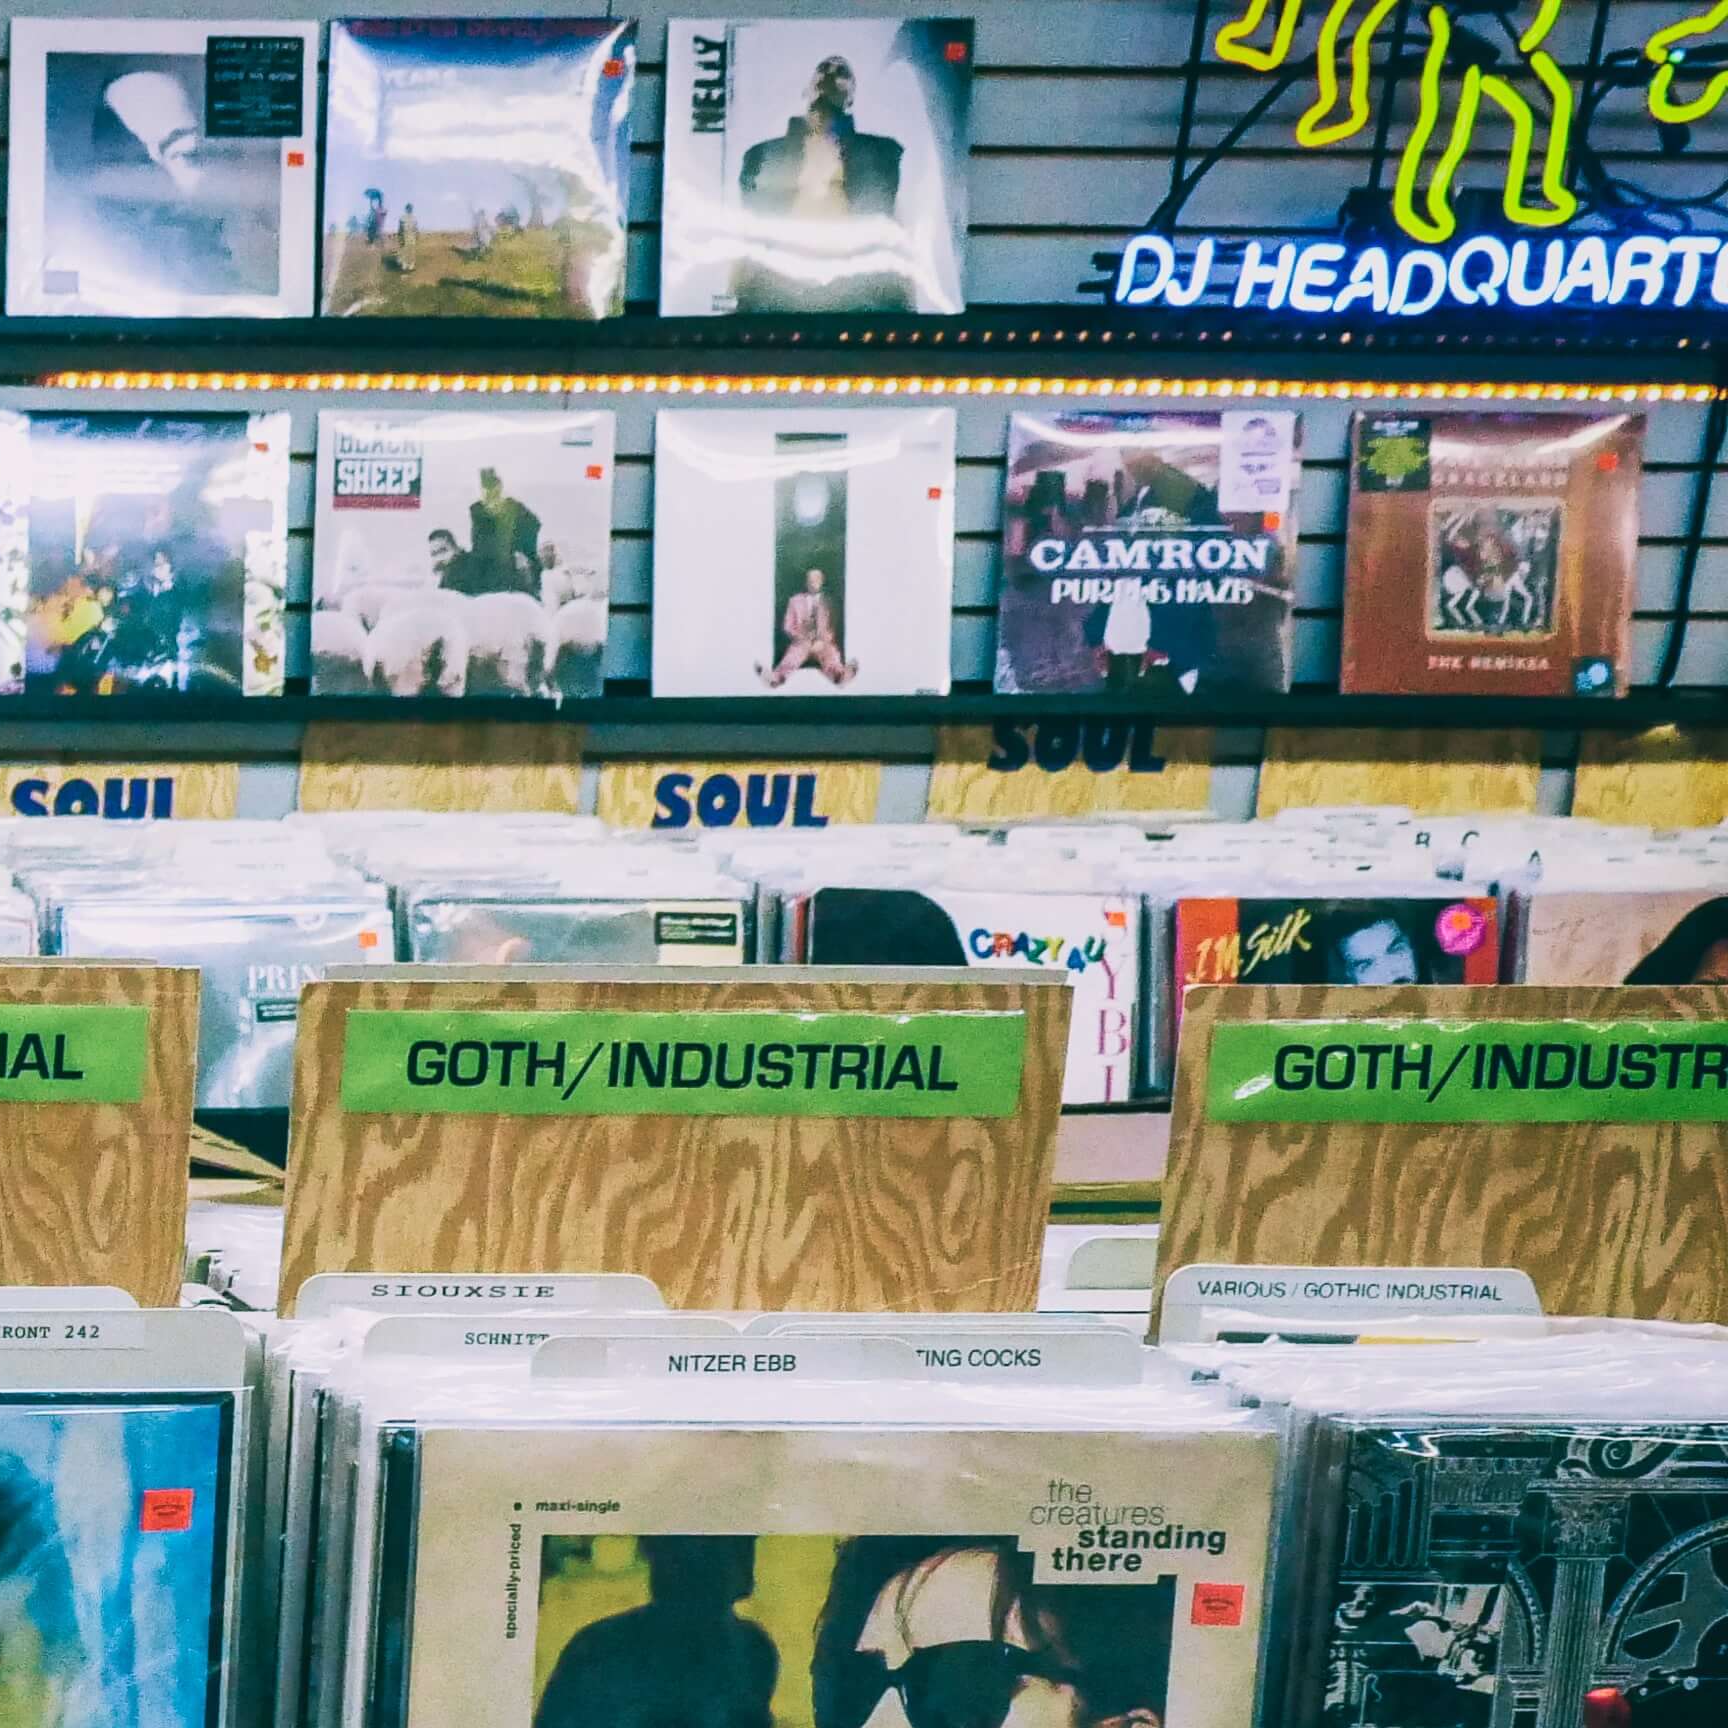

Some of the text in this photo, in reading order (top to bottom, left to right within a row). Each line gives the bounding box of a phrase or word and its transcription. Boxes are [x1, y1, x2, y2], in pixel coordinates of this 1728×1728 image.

[692, 35, 728, 132] NELLY
[1115, 236, 1214, 301] DJ
[337, 461, 419, 494] SHEEP
[990, 716, 1167, 775] SOUL
[652, 772, 828, 829] SOUL
[407, 1041, 959, 1100] GOTH/INDUSTRIAL
[370, 1283, 556, 1299] SIOUXSIE
[1196, 1281, 1287, 1299] VARIOUS
[1305, 1282, 1383, 1300] GOTHIC
[1386, 1283, 1503, 1301] INDUSTRIAL
[62, 1324, 100, 1340] 242
[667, 1353, 796, 1373] NITZER EBB
[535, 1498, 622, 1513] maxi-single
[1047, 1478, 1093, 1504] the
[1030, 1499, 1168, 1527] creatures
[1078, 1522, 1227, 1556] standing
[1050, 1545, 1143, 1574] there
[504, 1523, 523, 1640] specially-priced
